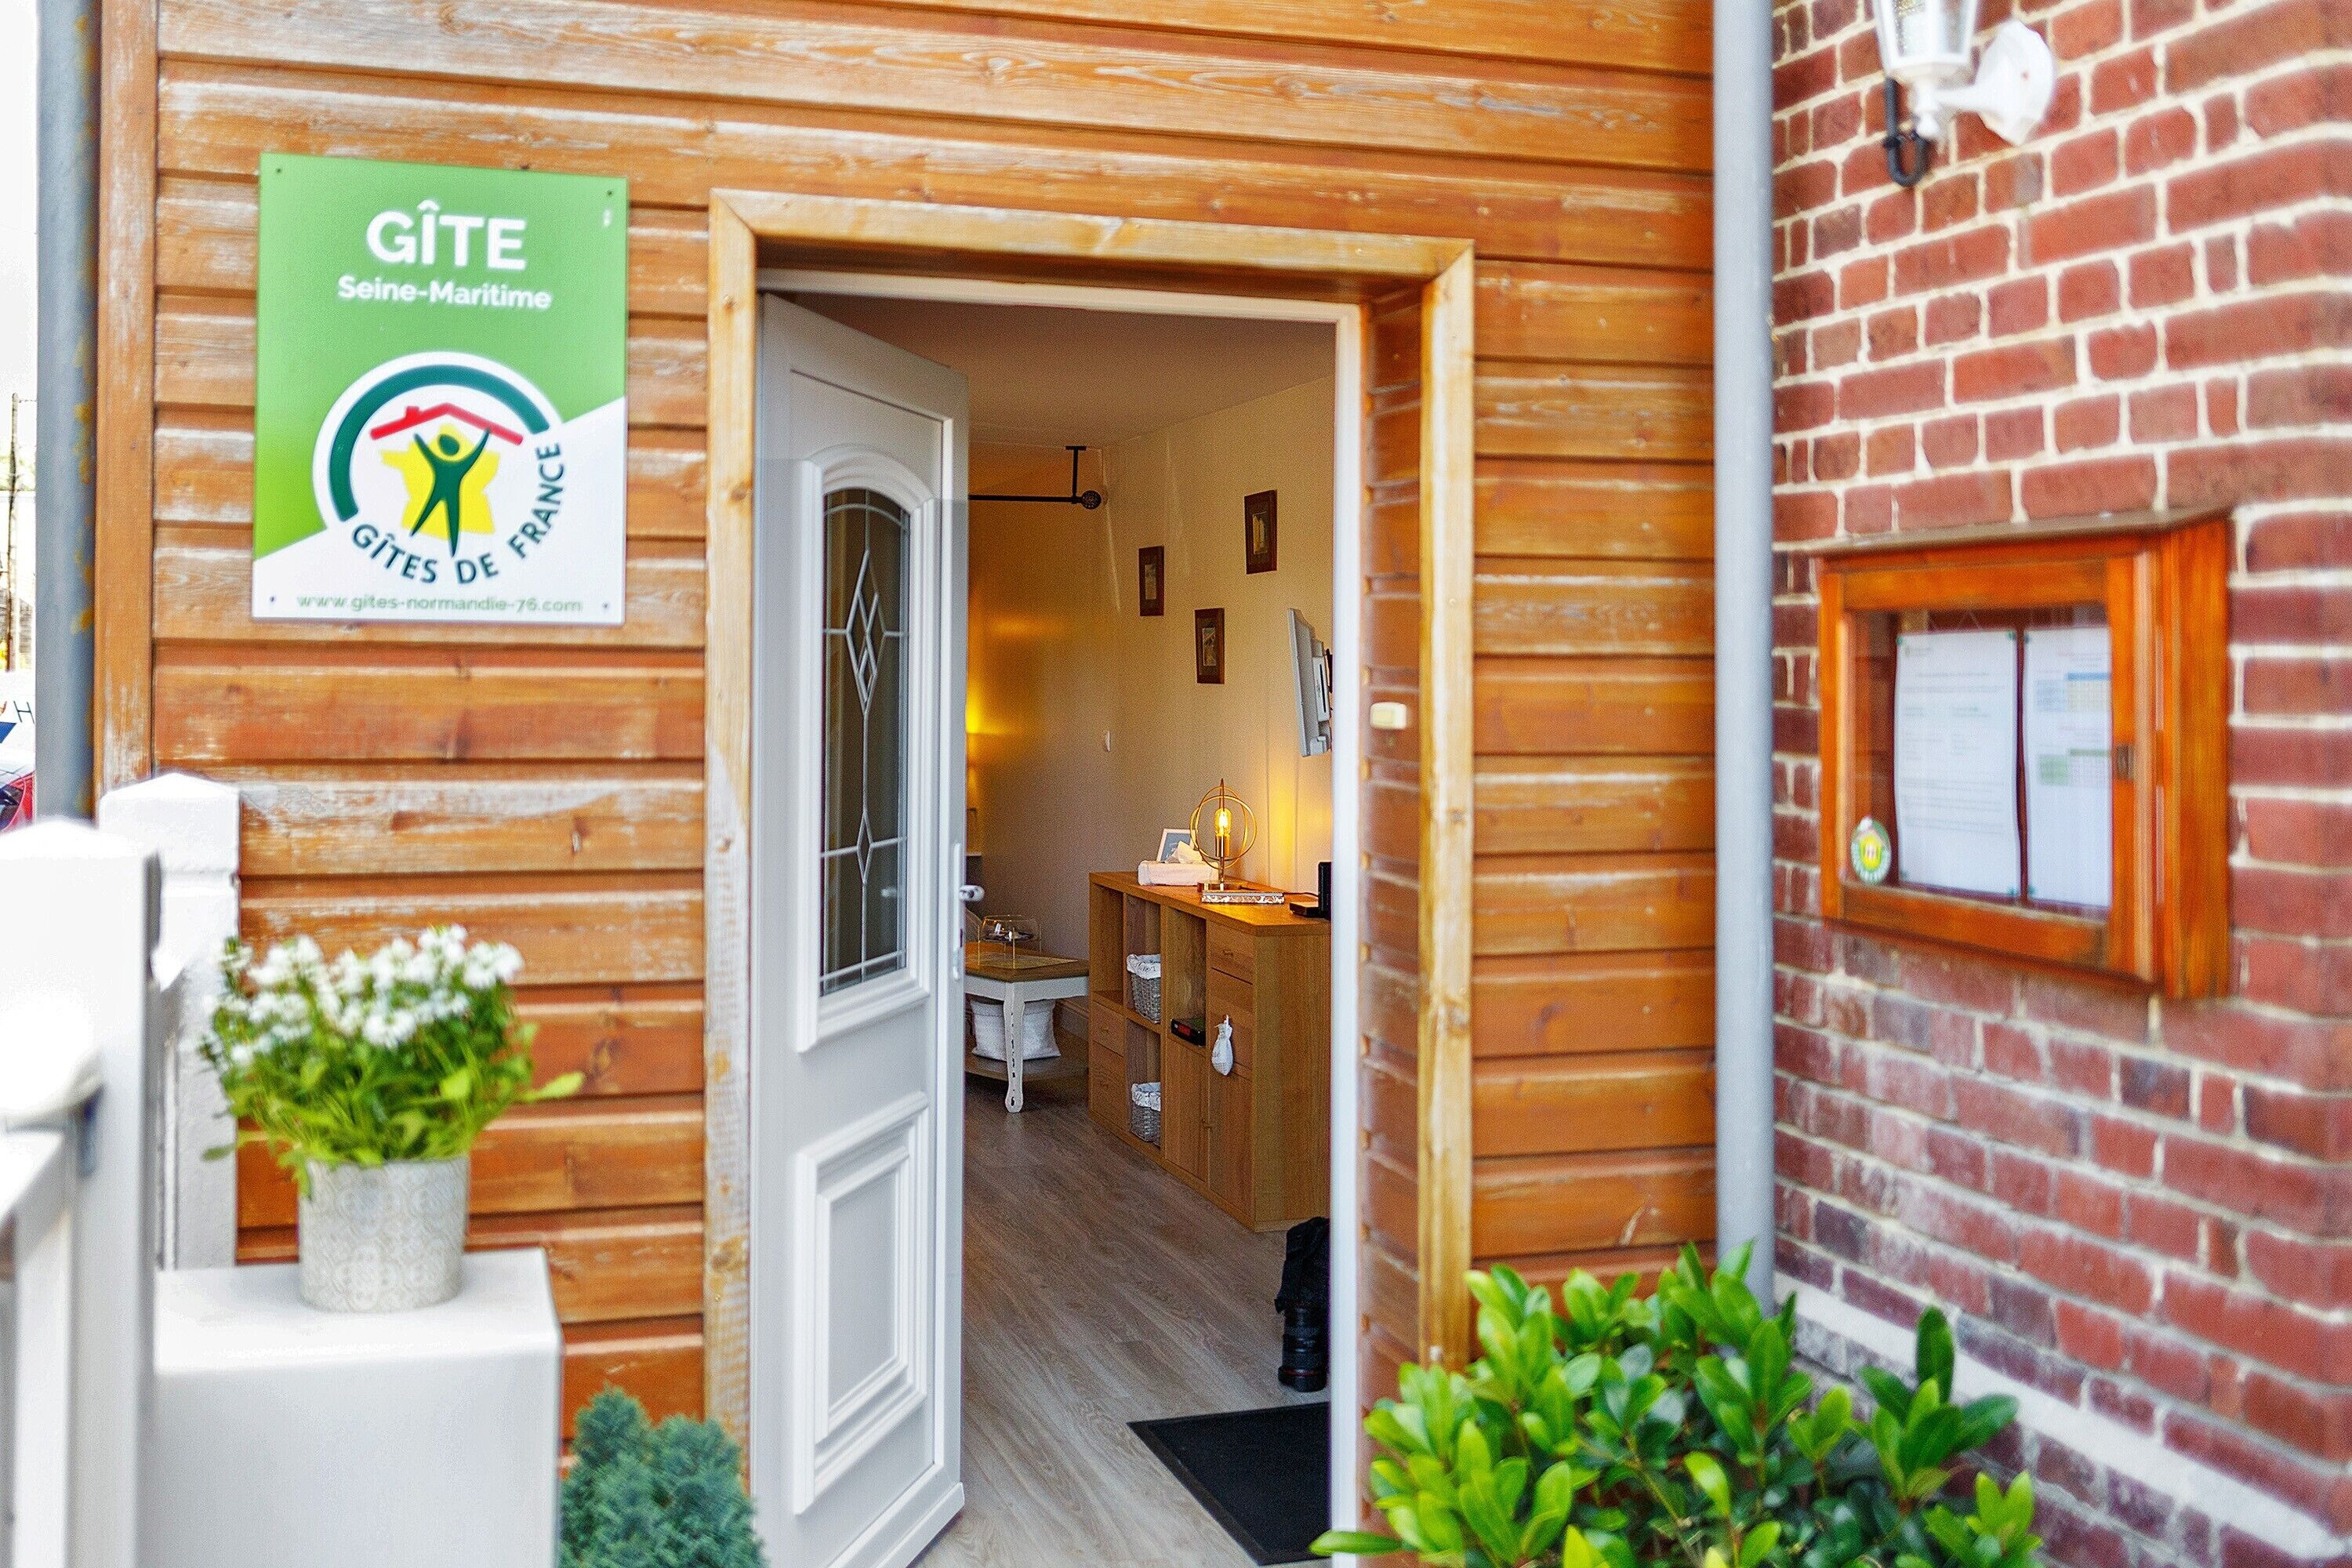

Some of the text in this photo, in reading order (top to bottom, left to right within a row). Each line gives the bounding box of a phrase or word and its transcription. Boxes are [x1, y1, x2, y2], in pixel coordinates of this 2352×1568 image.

[366, 199, 527, 270] GÎTE
[338, 274, 552, 309] Seine-Maritime
[352, 442, 564, 584] GÎTES DE FRANCE
[297, 593, 583, 613] www.gites-normandie-76.com
